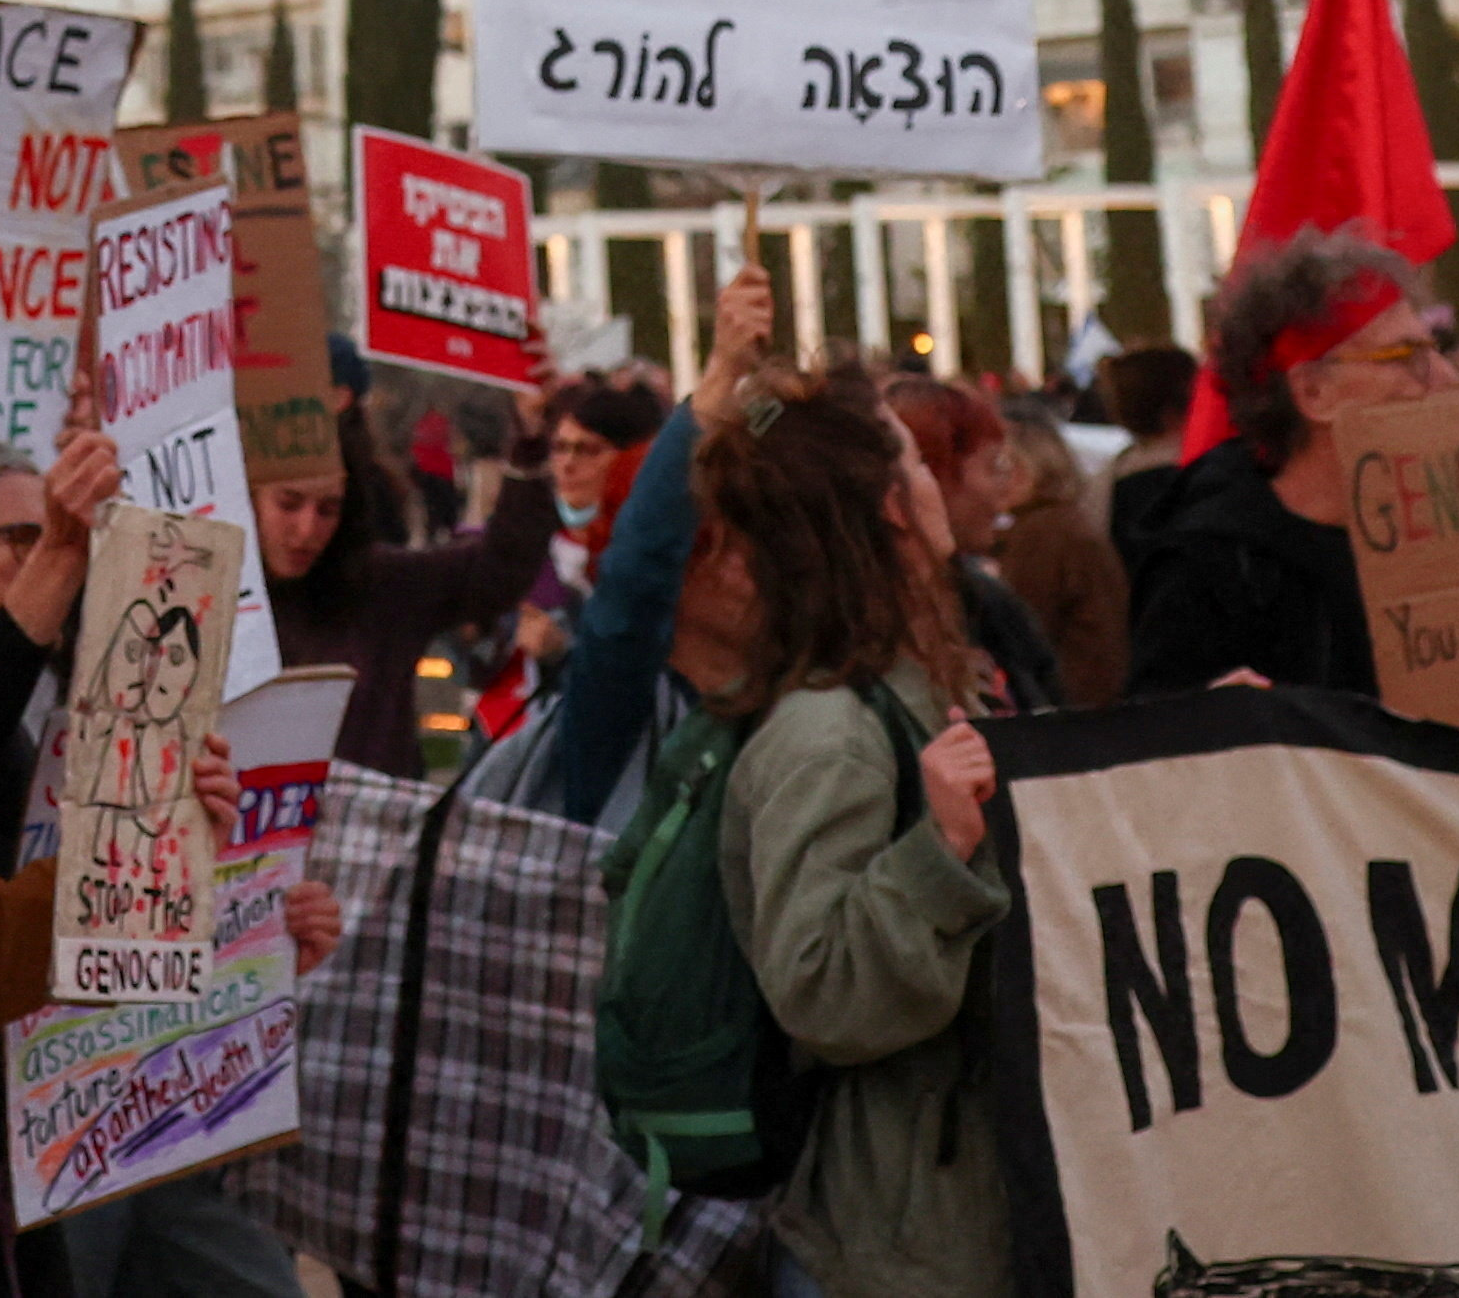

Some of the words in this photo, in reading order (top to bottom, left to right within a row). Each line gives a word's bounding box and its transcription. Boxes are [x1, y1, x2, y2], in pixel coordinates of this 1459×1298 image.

[9, 130, 112, 214] NOT
[7, 335, 72, 396] FOR
[145, 426, 216, 511] NOT
[1383, 601, 1459, 673] You
[76, 874, 135, 932] STOP
[76, 947, 202, 995] GENOCIDE
[1090, 853, 1338, 1134] NO
[18, 1067, 124, 1159] torture
[71, 1048, 194, 1179] apartheid
